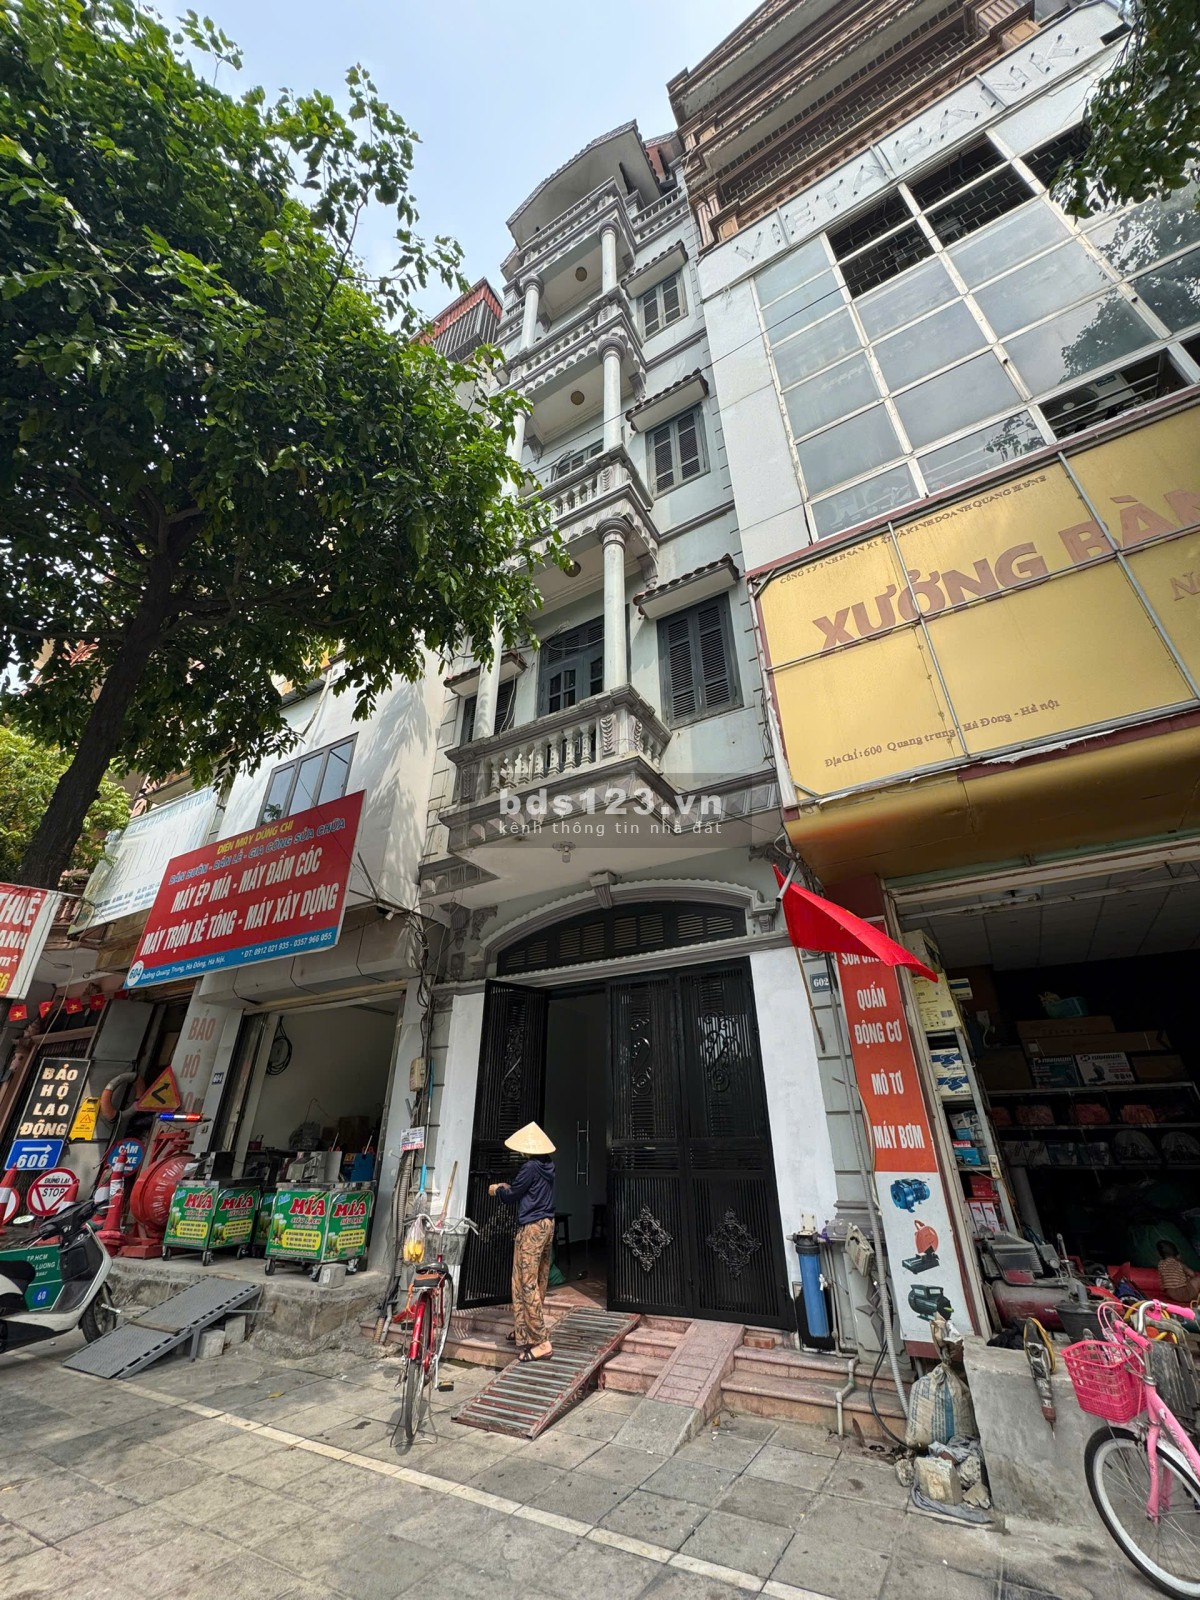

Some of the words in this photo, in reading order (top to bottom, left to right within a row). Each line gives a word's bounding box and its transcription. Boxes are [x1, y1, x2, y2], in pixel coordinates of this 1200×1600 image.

[973, 487, 1012, 508] QUANG
[812, 541, 1052, 659] XƯỞNG
[887, 736, 923, 752] Quang
[924, 728, 956, 742] trung
[1020, 703, 1039, 716] Hà
[280, 819, 295, 832] CHI
[170, 883, 197, 914] MÁY
[193, 879, 211, 907] ÉP
[208, 871, 232, 903] MÍA
[238, 861, 267, 894] MÁY
[295, 844, 323, 878] CÓC
[140, 925, 167, 957] MÁY
[163, 918, 193, 954] TRỘN
[189, 912, 209, 944] BÊ
[206, 909, 238, 940] TÔNG
[243, 896, 274, 931] MÁY
[272, 889, 301, 924] XÂY
[300, 882, 340, 921] DỰNG
[128, 966, 143, 980] 604
[156, 967, 171, 977] Quang
[813, 977, 829, 988] 602
[856, 981, 887, 1011] QUẤN
[854, 1020, 885, 1048] ĐỘNG
[886, 1019, 903, 1042] CƠ
[42, 1063, 78, 1081] BẢO
[40, 1083, 70, 1100] HỘ
[871, 1068, 890, 1096] MÔ
[889, 1070, 904, 1095] TƠ
[32, 1103, 70, 1116] LAO
[20, 1119, 68, 1138] ĐỘNG
[873, 1120, 897, 1149] MÁY
[898, 1123, 926, 1149] BƠM
[16, 1154, 49, 1168] 606
[42, 1187, 66, 1197] STOP
[184, 1190, 212, 1210] MÍA
[219, 1193, 254, 1210] MÍA
[289, 1195, 325, 1217] MÍA
[333, 1200, 366, 1217] MÍA
